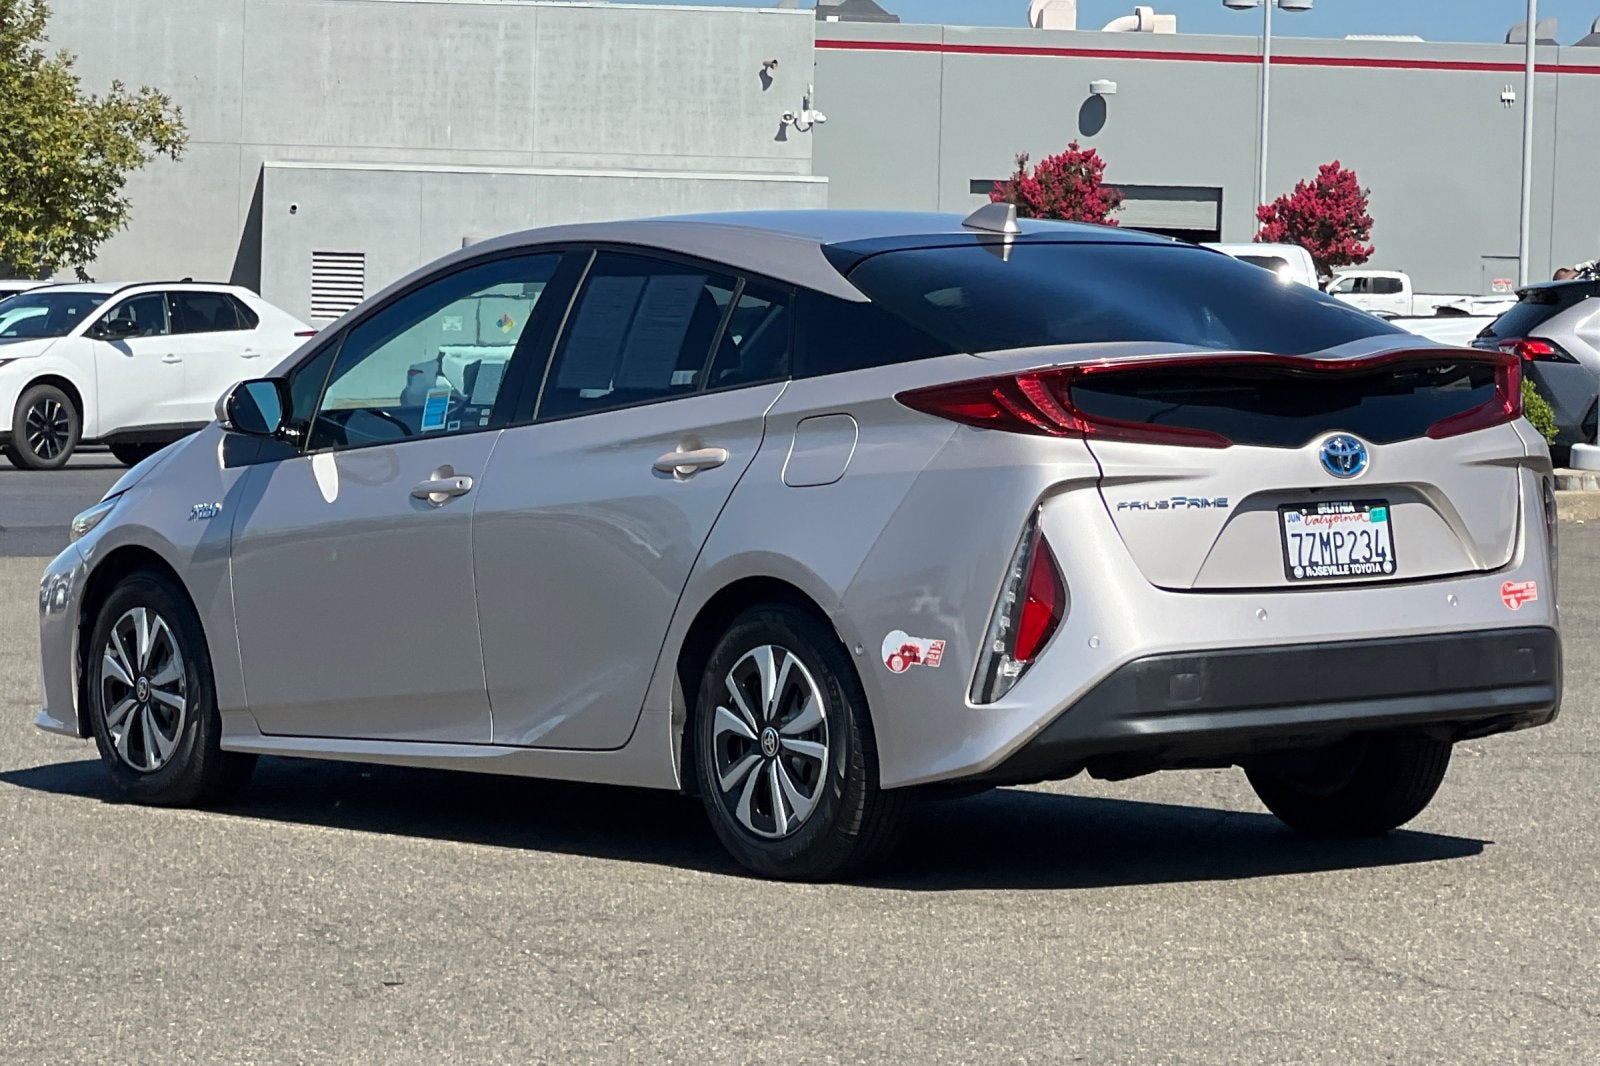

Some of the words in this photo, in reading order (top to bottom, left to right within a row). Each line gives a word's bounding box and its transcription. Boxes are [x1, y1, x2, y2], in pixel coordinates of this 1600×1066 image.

[1117, 501, 1169, 511] PRIUS
[1170, 496, 1229, 509] PRIME
[1288, 512, 1301, 522] JUN
[1304, 513, 1370, 529] California
[1291, 529, 1386, 566] 7ZMP234
[1306, 564, 1350, 577] ROSEVILLE
[1351, 562, 1381, 574] TOYOTA
